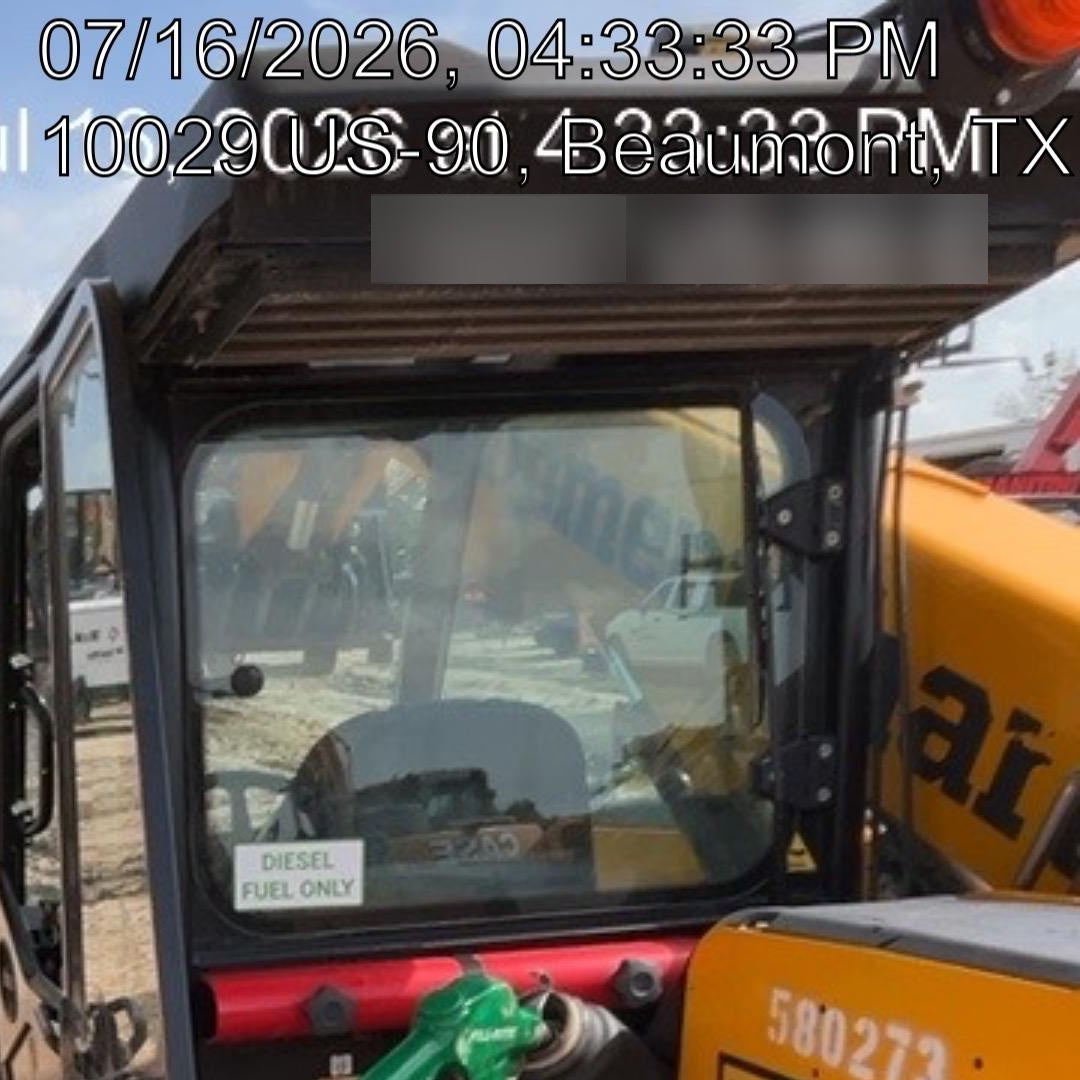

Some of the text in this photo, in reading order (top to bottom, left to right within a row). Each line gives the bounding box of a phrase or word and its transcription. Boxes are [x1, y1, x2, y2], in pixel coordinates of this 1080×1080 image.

[261, 851, 336, 871] DIESEL
[241, 878, 356, 901] FUEL ONLY
